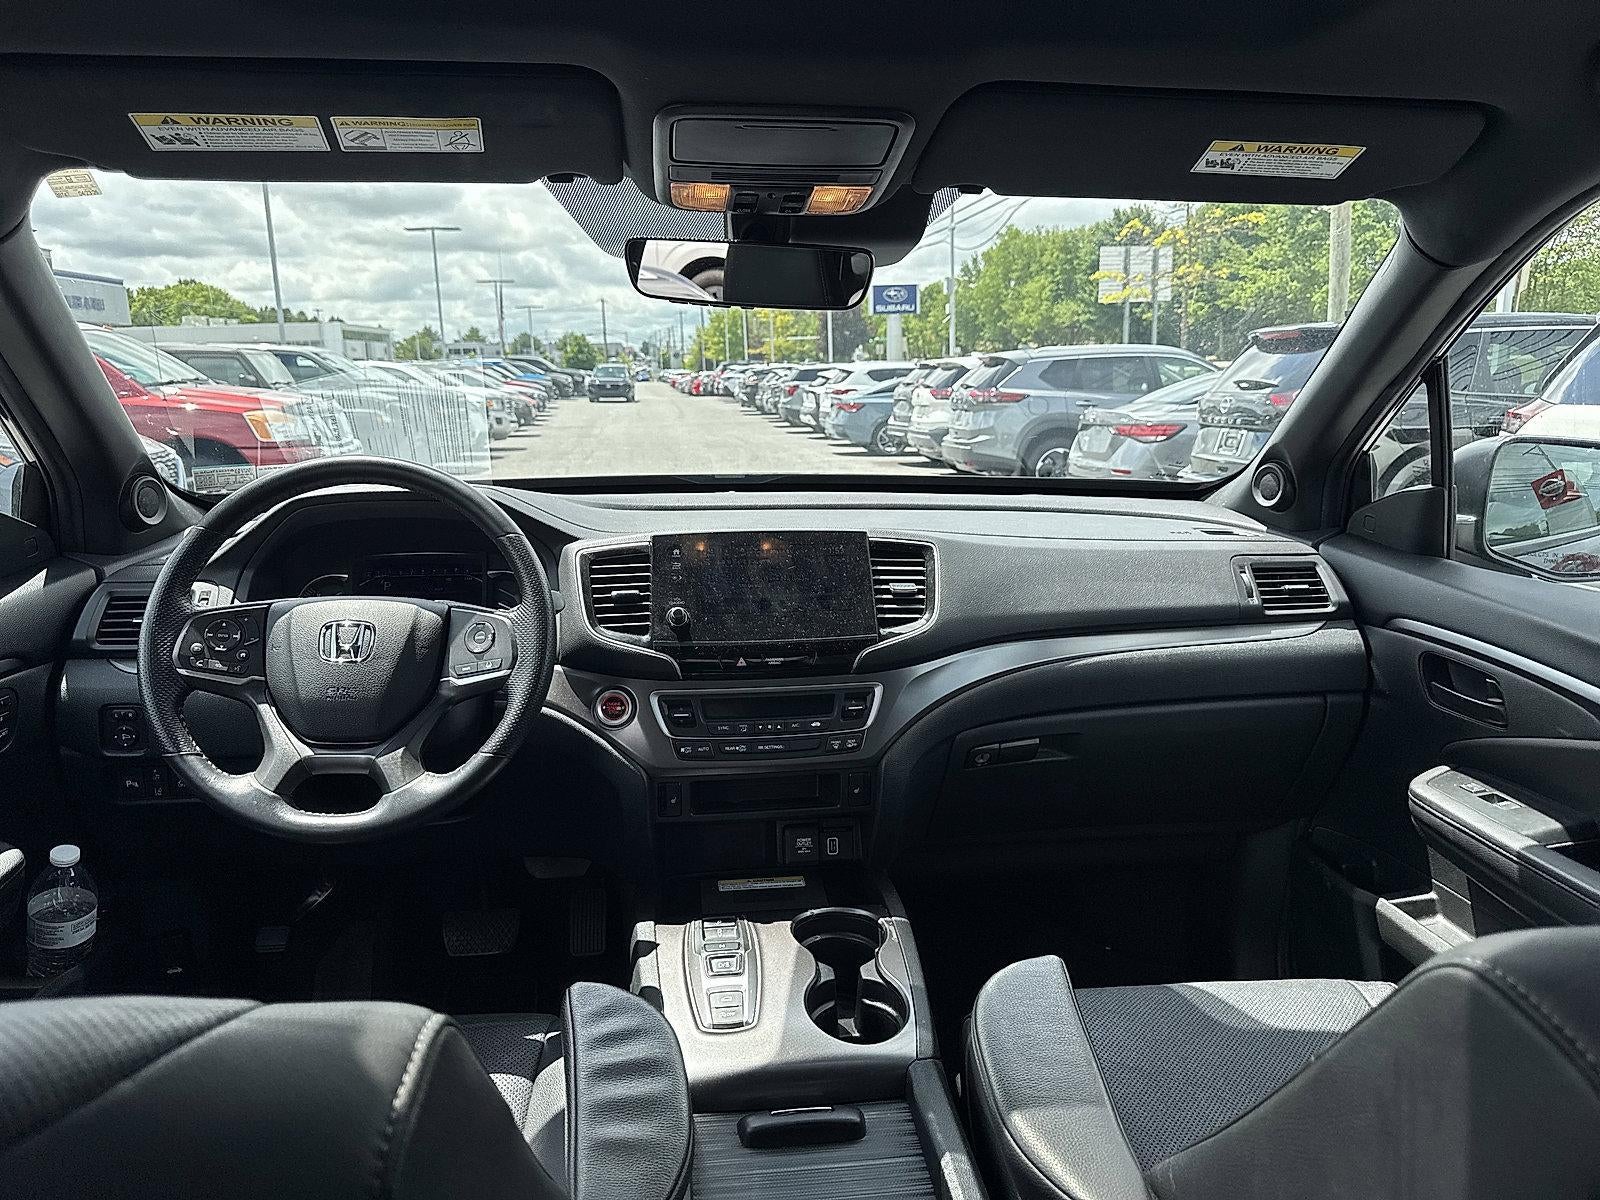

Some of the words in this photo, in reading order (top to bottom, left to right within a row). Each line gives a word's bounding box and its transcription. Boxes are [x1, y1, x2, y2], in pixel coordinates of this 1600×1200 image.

[189, 116, 294, 127] WARNING
[1256, 144, 1340, 156] WARNING
[875, 304, 915, 313] SUBARU
